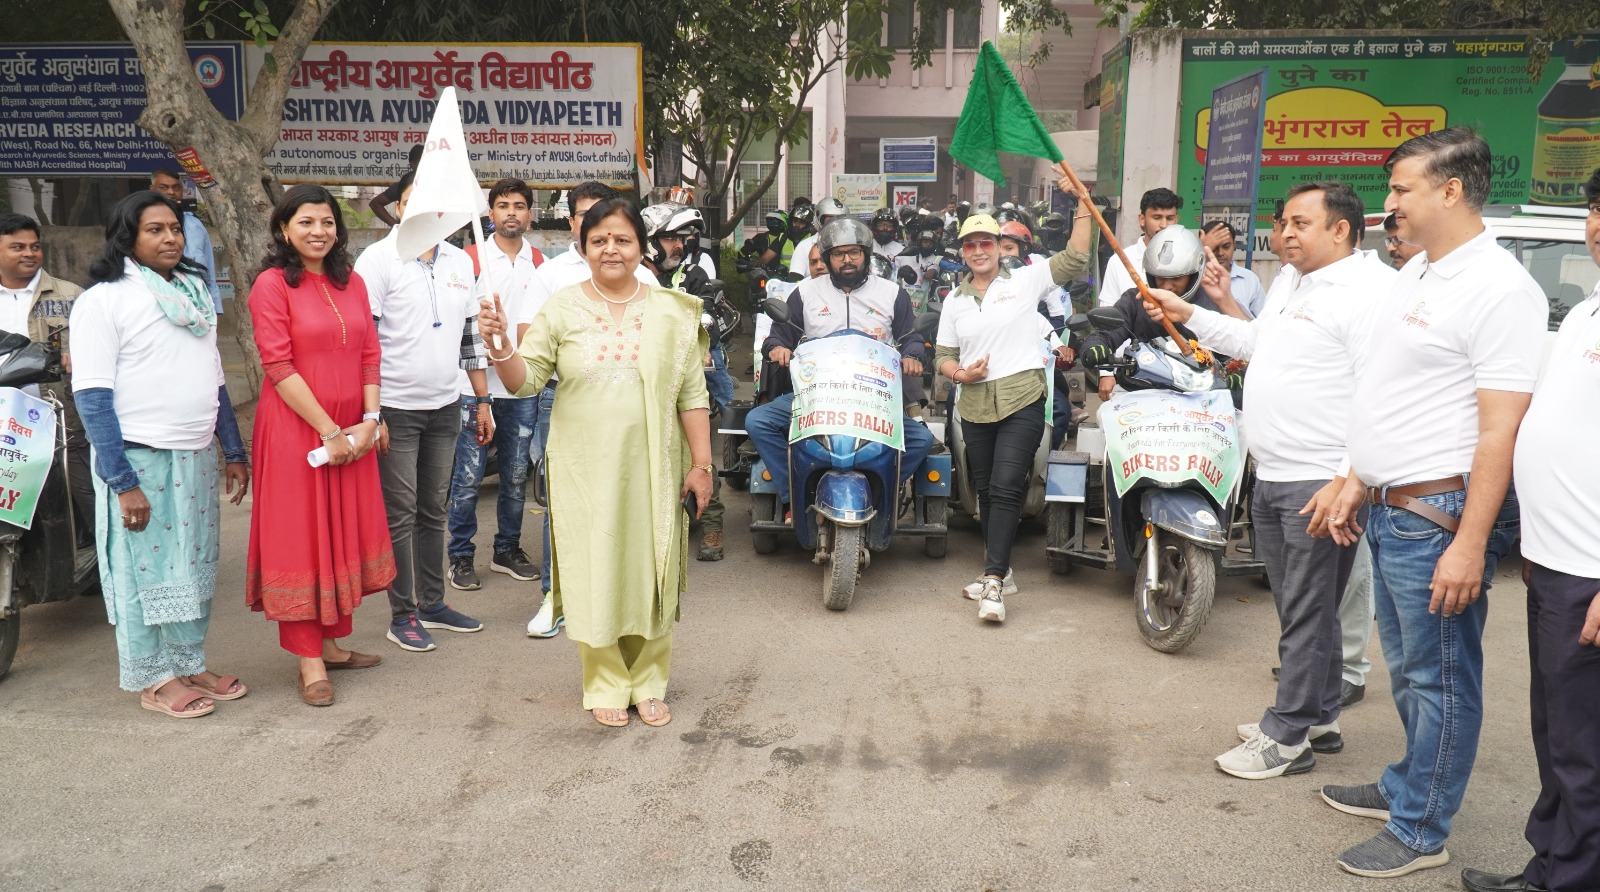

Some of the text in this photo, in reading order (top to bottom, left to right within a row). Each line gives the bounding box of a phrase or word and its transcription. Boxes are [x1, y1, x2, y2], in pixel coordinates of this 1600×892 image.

[1192, 41, 1216, 56] बालों
[1220, 41, 1235, 55] की
[1238, 41, 1260, 55] सभी
[1331, 44, 1349, 56] एक
[1353, 40, 1366, 55] ही
[1369, 43, 1398, 55] इलाज
[1404, 39, 1424, 57] पुने
[1429, 42, 1447, 53] का
[0, 52, 37, 82] युर्वेद
[42, 54, 120, 82] अनुसंधान
[376, 50, 475, 99] आयुर्वेद
[478, 51, 595, 91] विद्यापीठ
[1466, 65, 1483, 74] ISO
[1278, 64, 1369, 87] पुने का
[1456, 76, 1495, 85] Certified
[79, 83, 92, 94] नई
[1462, 87, 1481, 97] Reg.
[1485, 87, 1500, 95] No.
[30, 97, 67, 109] अनुसंधान
[98, 98, 121, 108] आयुष
[282, 98, 622, 126] SHTRIYA AYURDA VIDYAPEETH
[53, 123, 136, 138] RESEARCH
[1381, 112, 1435, 138] तेल
[364, 130, 399, 147] आयुष
[403, 127, 428, 144] मंत्रा
[469, 128, 507, 146] अधीन
[511, 132, 528, 146] एक
[1, 140, 168, 151] (West), Road No. 66, New Delhi-1100
[24, 151, 31, 160] in
[32, 151, 67, 161] Ayurvedic
[103, 151, 131, 161] Ministry
[133, 151, 140, 160] of
[280, 148, 357, 159] autonomous
[362, 150, 410, 164] organis
[487, 151, 531, 165] Ministry
[535, 151, 547, 162] of
[609, 150, 631, 167] India)
[1278, 153, 1299, 162] का
[0, 161, 126, 170] ith NABH Accredited Hospital)
[7, 417, 33, 439] दिवस
[853, 412, 895, 438] RALLY
[1182, 423, 1191, 433] के
[1122, 452, 1225, 489] BIKERS RALLY
